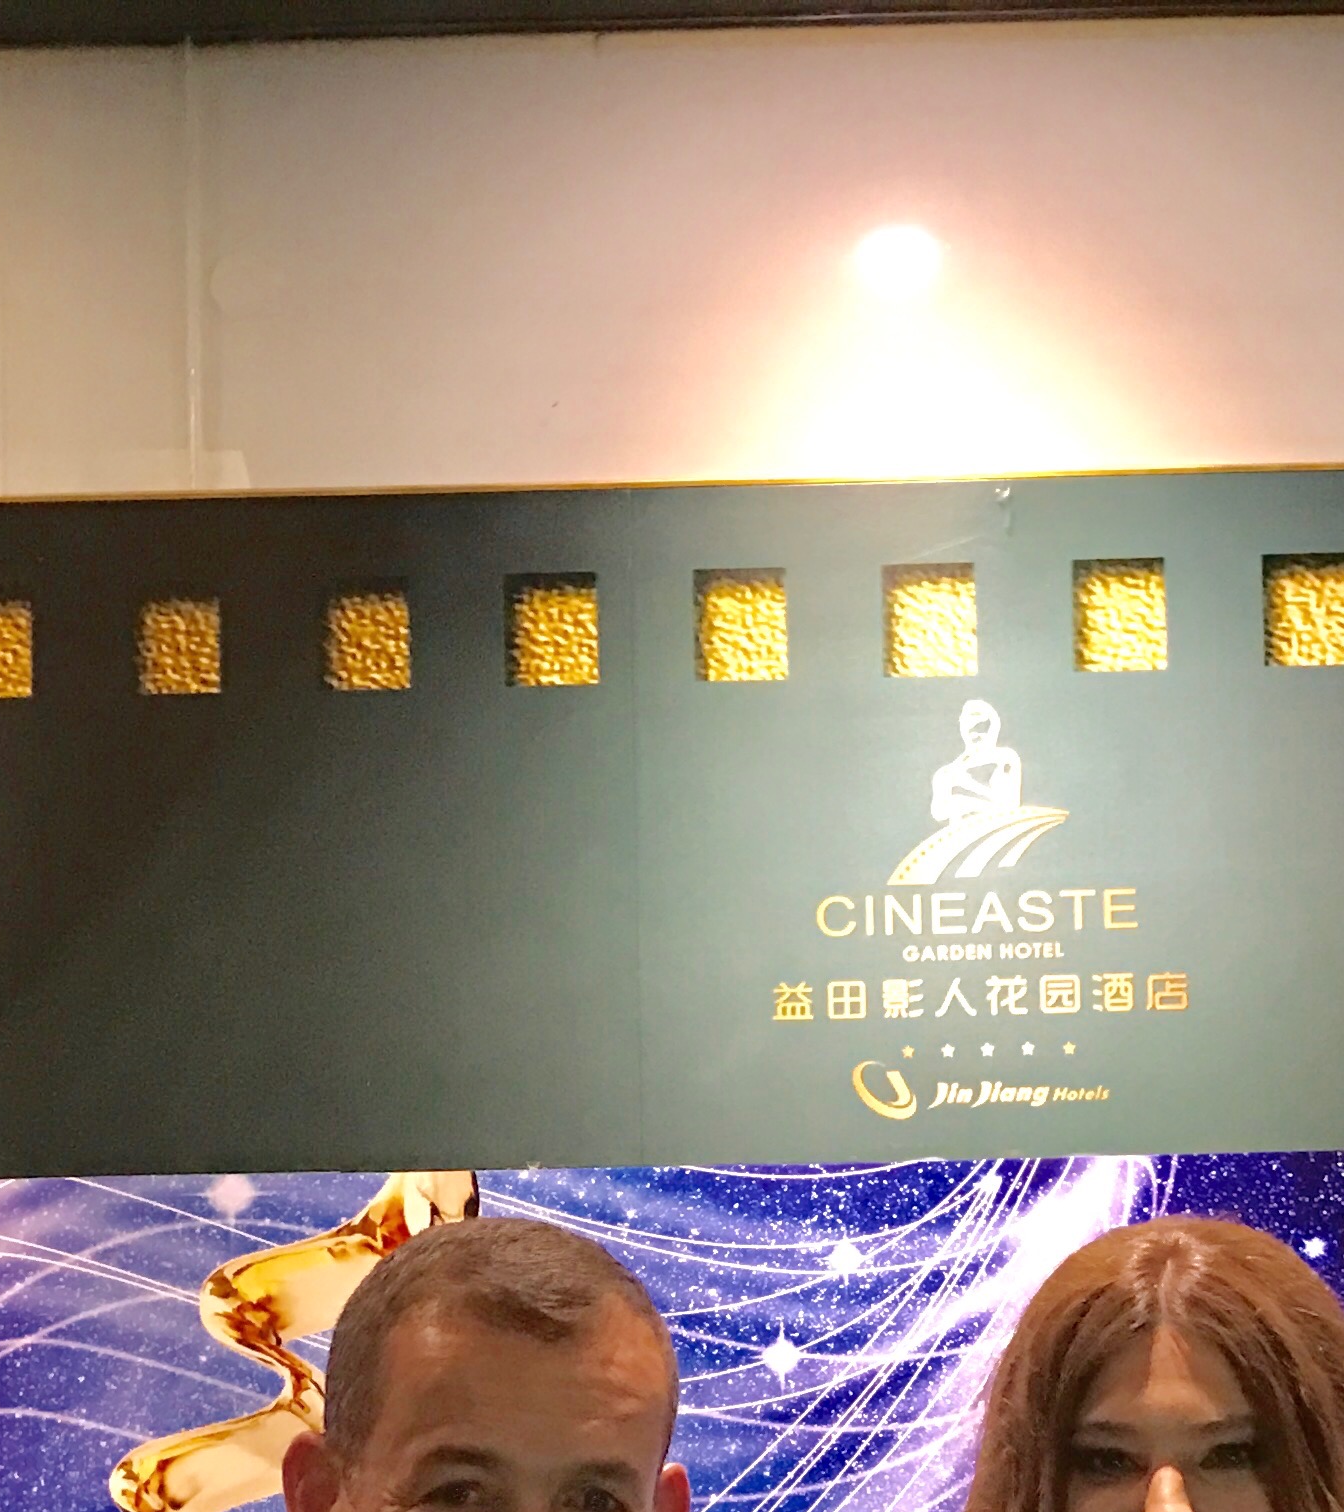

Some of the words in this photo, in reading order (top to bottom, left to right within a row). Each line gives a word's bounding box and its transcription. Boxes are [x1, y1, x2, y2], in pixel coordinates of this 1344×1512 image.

[816, 888, 1138, 937] CINEASTE
[903, 944, 992, 962] GARDEN
[999, 942, 1064, 960] HOTEL
[772, 971, 1189, 1021] 益田影人花园酒店
[1052, 1085, 1110, 1101] Hotels
